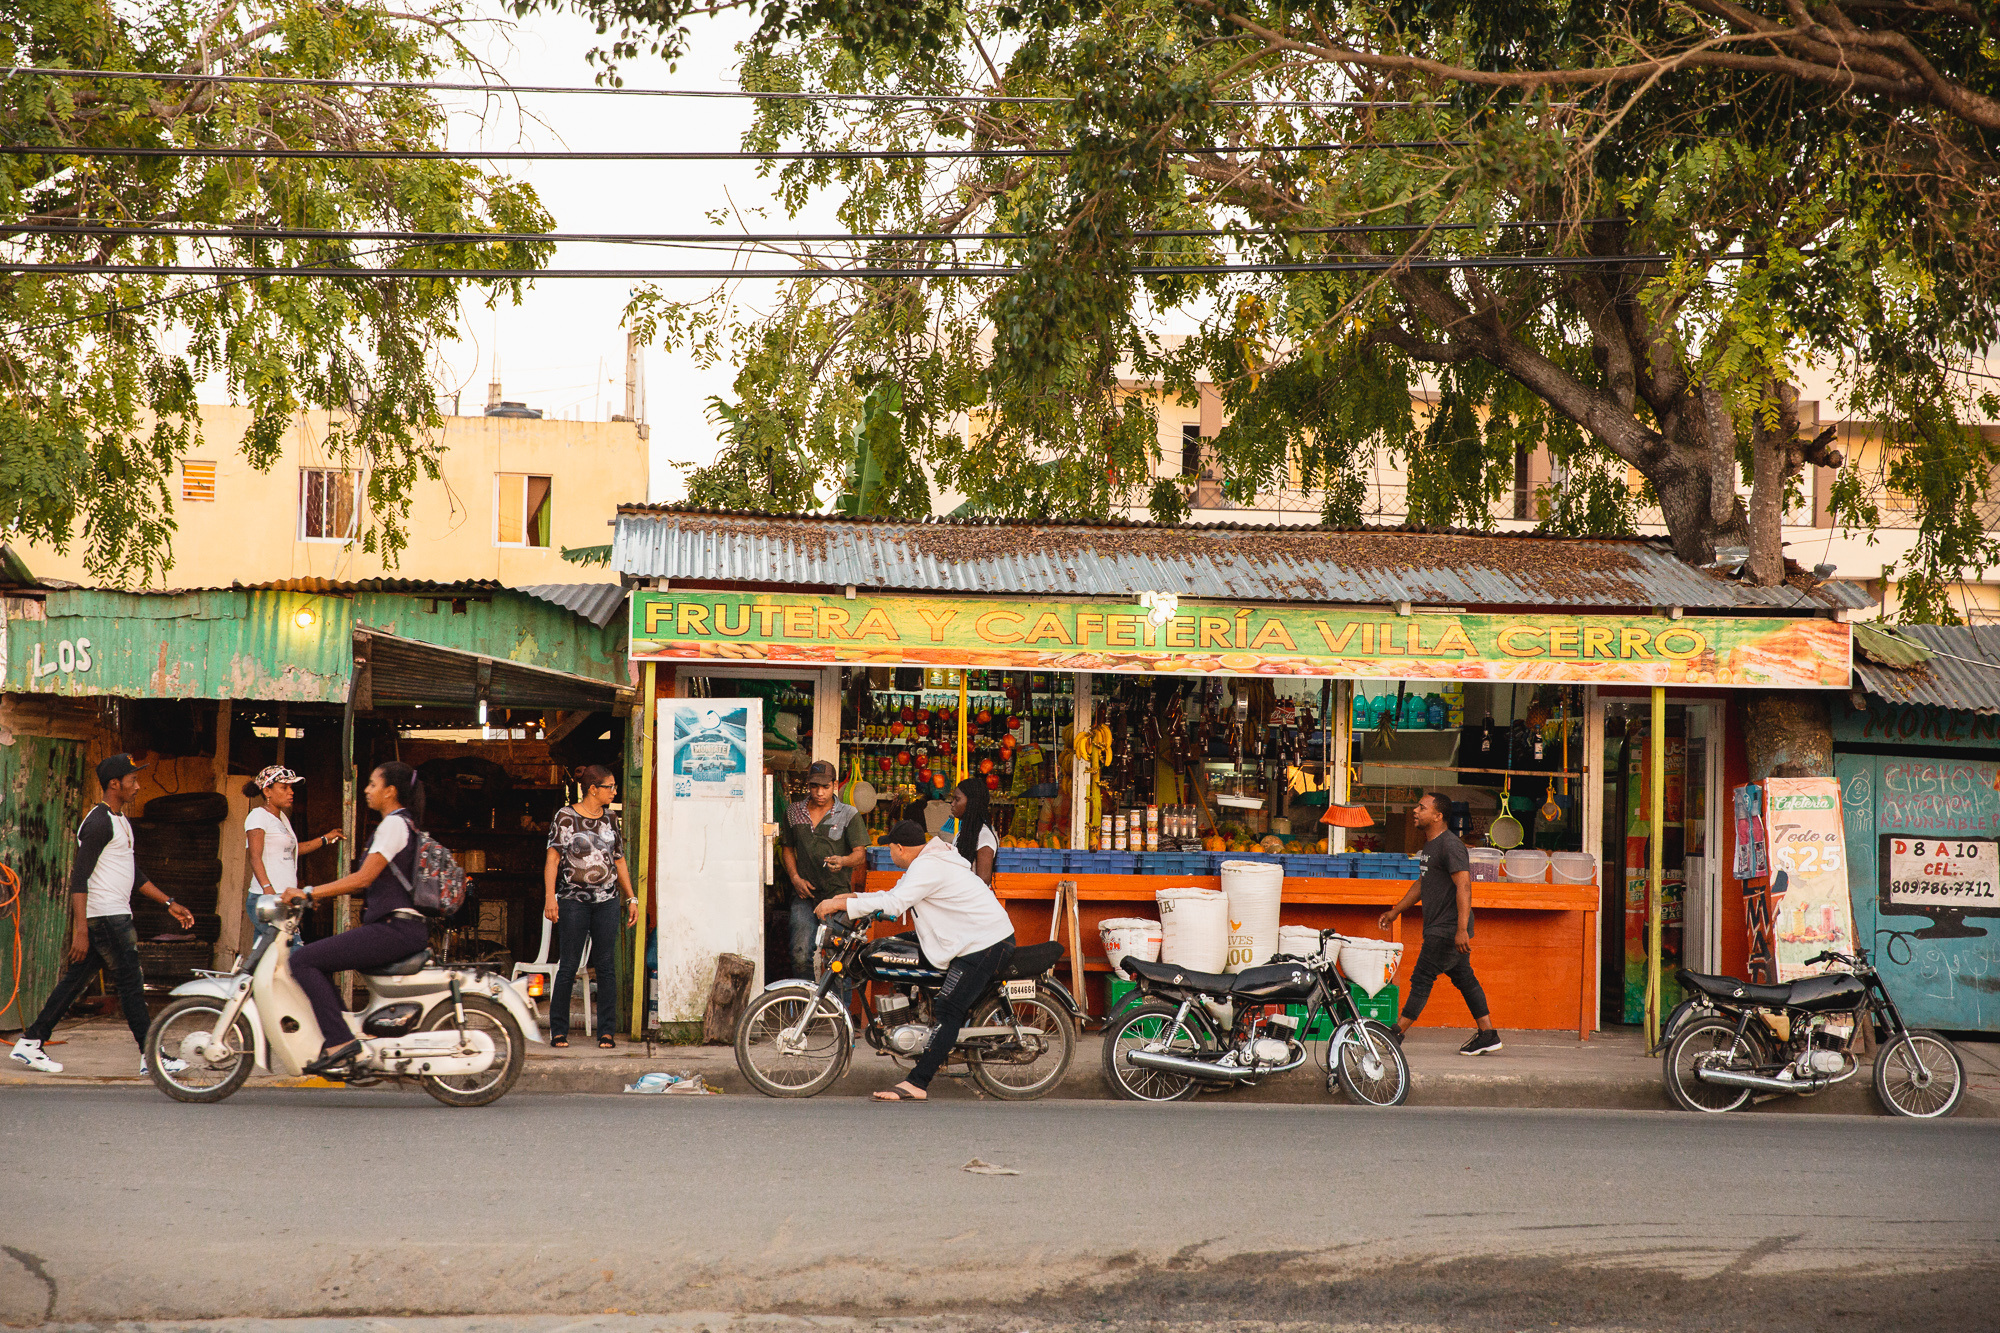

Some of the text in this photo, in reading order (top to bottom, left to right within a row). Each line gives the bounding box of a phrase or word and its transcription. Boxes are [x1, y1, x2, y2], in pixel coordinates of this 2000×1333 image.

[645, 601, 1707, 661] FRUTERA Y CAFETERÍA VILLA CERRO
[33, 637, 92, 678] LOS
[1774, 824, 1838, 844] Todo a
[1776, 846, 1841, 872] $25
[1894, 840, 1979, 859] D 8 A 10
[882, 955, 919, 965] SUZUKI
